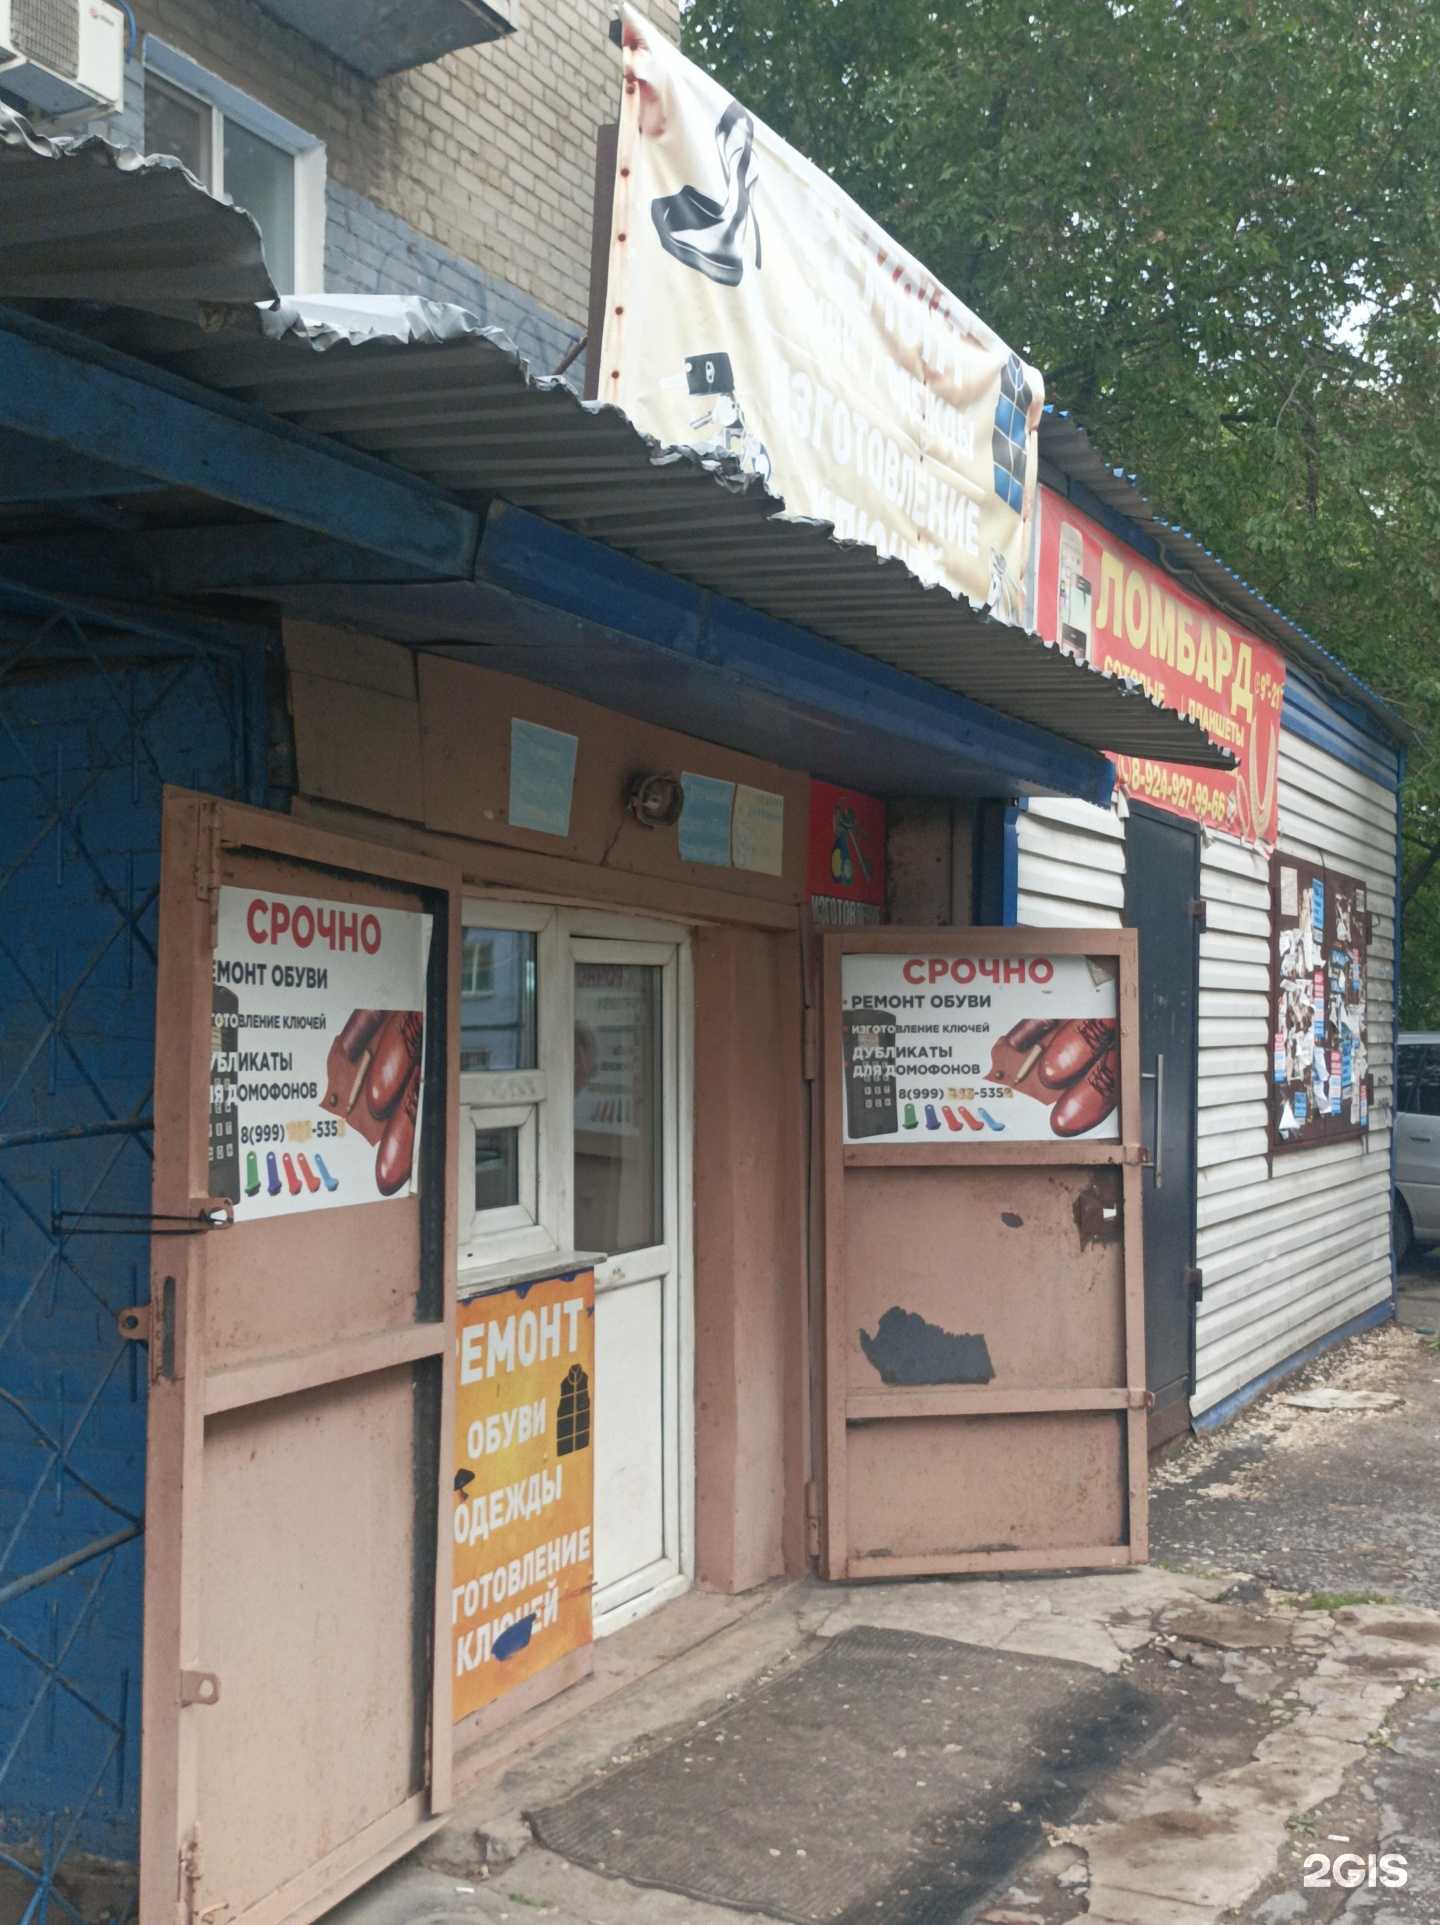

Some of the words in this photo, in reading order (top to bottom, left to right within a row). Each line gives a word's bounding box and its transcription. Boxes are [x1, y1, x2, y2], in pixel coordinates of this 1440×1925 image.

[1096, 551, 1253, 724] ЛОМБАРД
[247, 898, 382, 955] СРОЧНО
[213, 959, 267, 986] МОНТ
[272, 964, 328, 989] ОБУВИ
[903, 958, 1054, 985] СРОЧНО
[852, 995, 925, 1009] РЕМОНТ
[930, 994, 991, 1009] ОБУВИ
[283, 1013, 327, 1030] КЛЮЧЕЙ
[851, 1023, 940, 1034] ИЗГОТОВЛЕНИЕ
[943, 1022, 990, 1034] КЛЮЧЕЙ
[852, 1046, 953, 1061] ДУБЛИКАТЫ
[853, 1064, 883, 1078] ДЛЯ
[886, 1064, 981, 1078] ДОМОФОНОВ
[898, 1088, 945, 1101] 8(999)
[240, 1123, 285, 1146] 8(999)
[456, 1297, 584, 1386] ЕМОНТ
[467, 1398, 546, 1459] ОБУВИ
[454, 1464, 562, 1547] ОДЕЖДЫ
[452, 1526, 591, 1625] ГОТОВЛЕНИЕ
